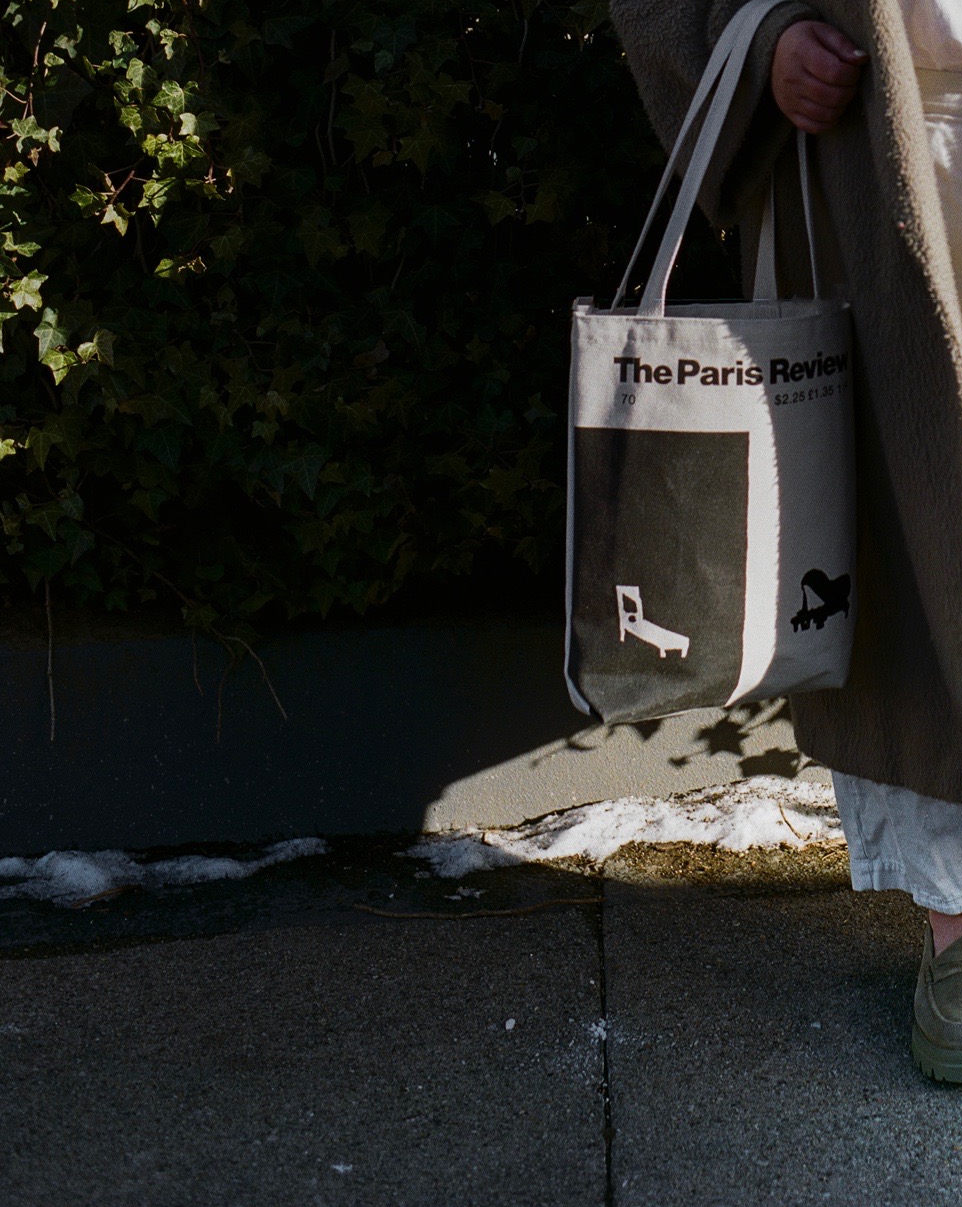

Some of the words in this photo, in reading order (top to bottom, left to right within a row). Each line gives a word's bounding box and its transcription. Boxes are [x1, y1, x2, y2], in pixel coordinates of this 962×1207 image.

[613, 356, 673, 384] The
[677, 358, 763, 386] Paris
[770, 351, 849, 385] Review
[621, 394, 636, 405] 70
[774, 390, 805, 406] $2.25
[808, 385, 834, 401] £1.35
